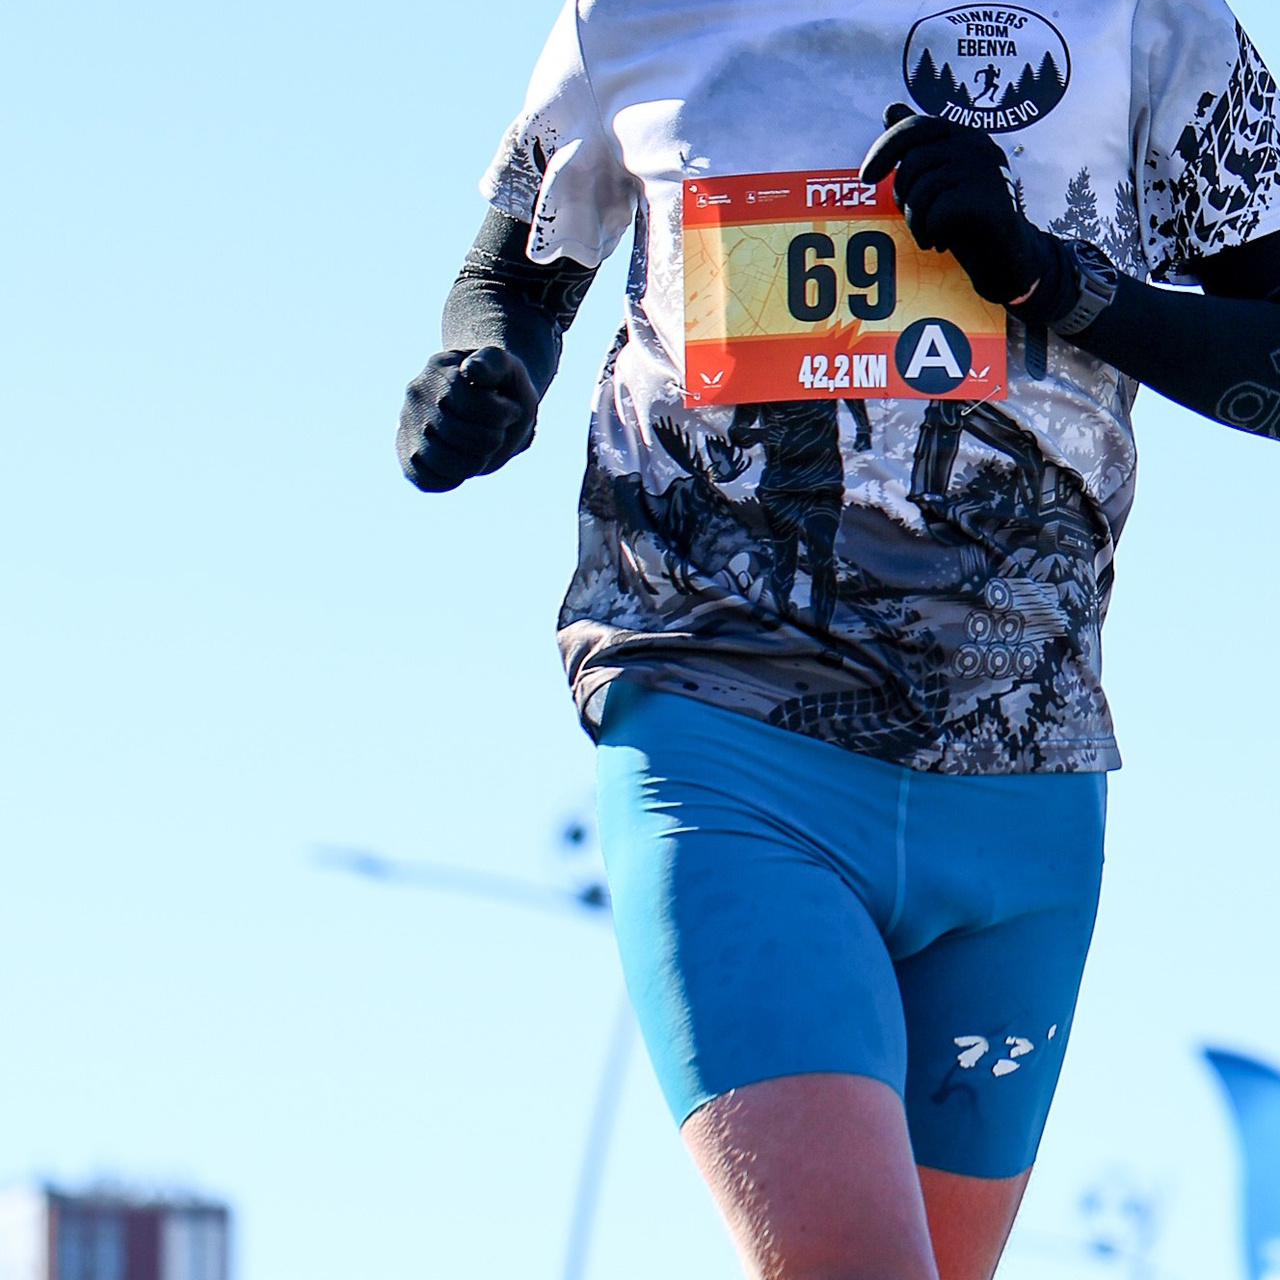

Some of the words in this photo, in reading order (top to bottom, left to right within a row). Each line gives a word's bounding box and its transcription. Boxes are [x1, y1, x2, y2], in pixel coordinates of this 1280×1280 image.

[945, 10, 1028, 29] RUNNERS
[966, 23, 1008, 37] FROM
[957, 39, 1017, 56] EBENYA
[939, 100, 1039, 129] TONSHAEVO
[787, 230, 896, 321] 69
[904, 324, 964, 379] A
[799, 355, 848, 392] 42,2
